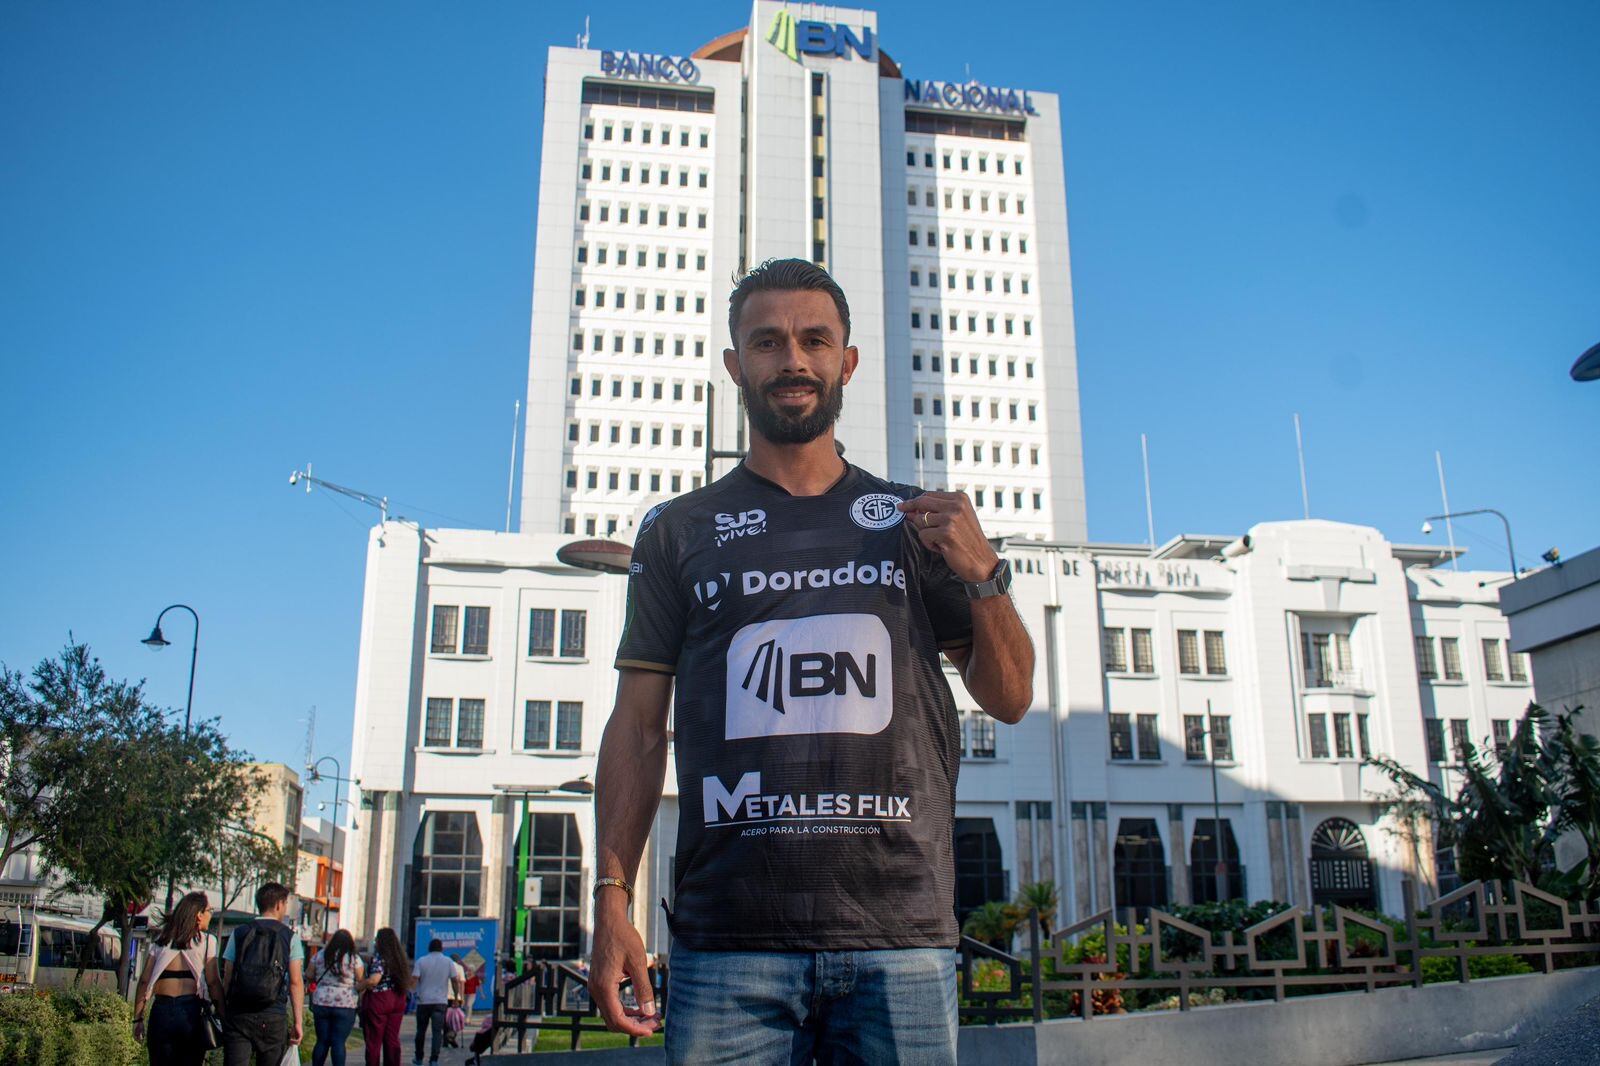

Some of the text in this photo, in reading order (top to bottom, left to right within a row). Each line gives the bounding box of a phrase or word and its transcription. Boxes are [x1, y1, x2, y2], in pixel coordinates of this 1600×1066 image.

[796, 20, 871, 59] BN
[601, 51, 697, 82] BANCO
[904, 79, 1037, 116] NACIONAL
[858, 494, 900, 506] SPORTING
[742, 561, 906, 596] DoradoBe
[1062, 560, 1080, 577] DE
[789, 651, 876, 698] BN
[703, 771, 911, 823] METALES FLIX
[741, 825, 880, 837] ACERO PARA LA CONSTRUCCIÓN
